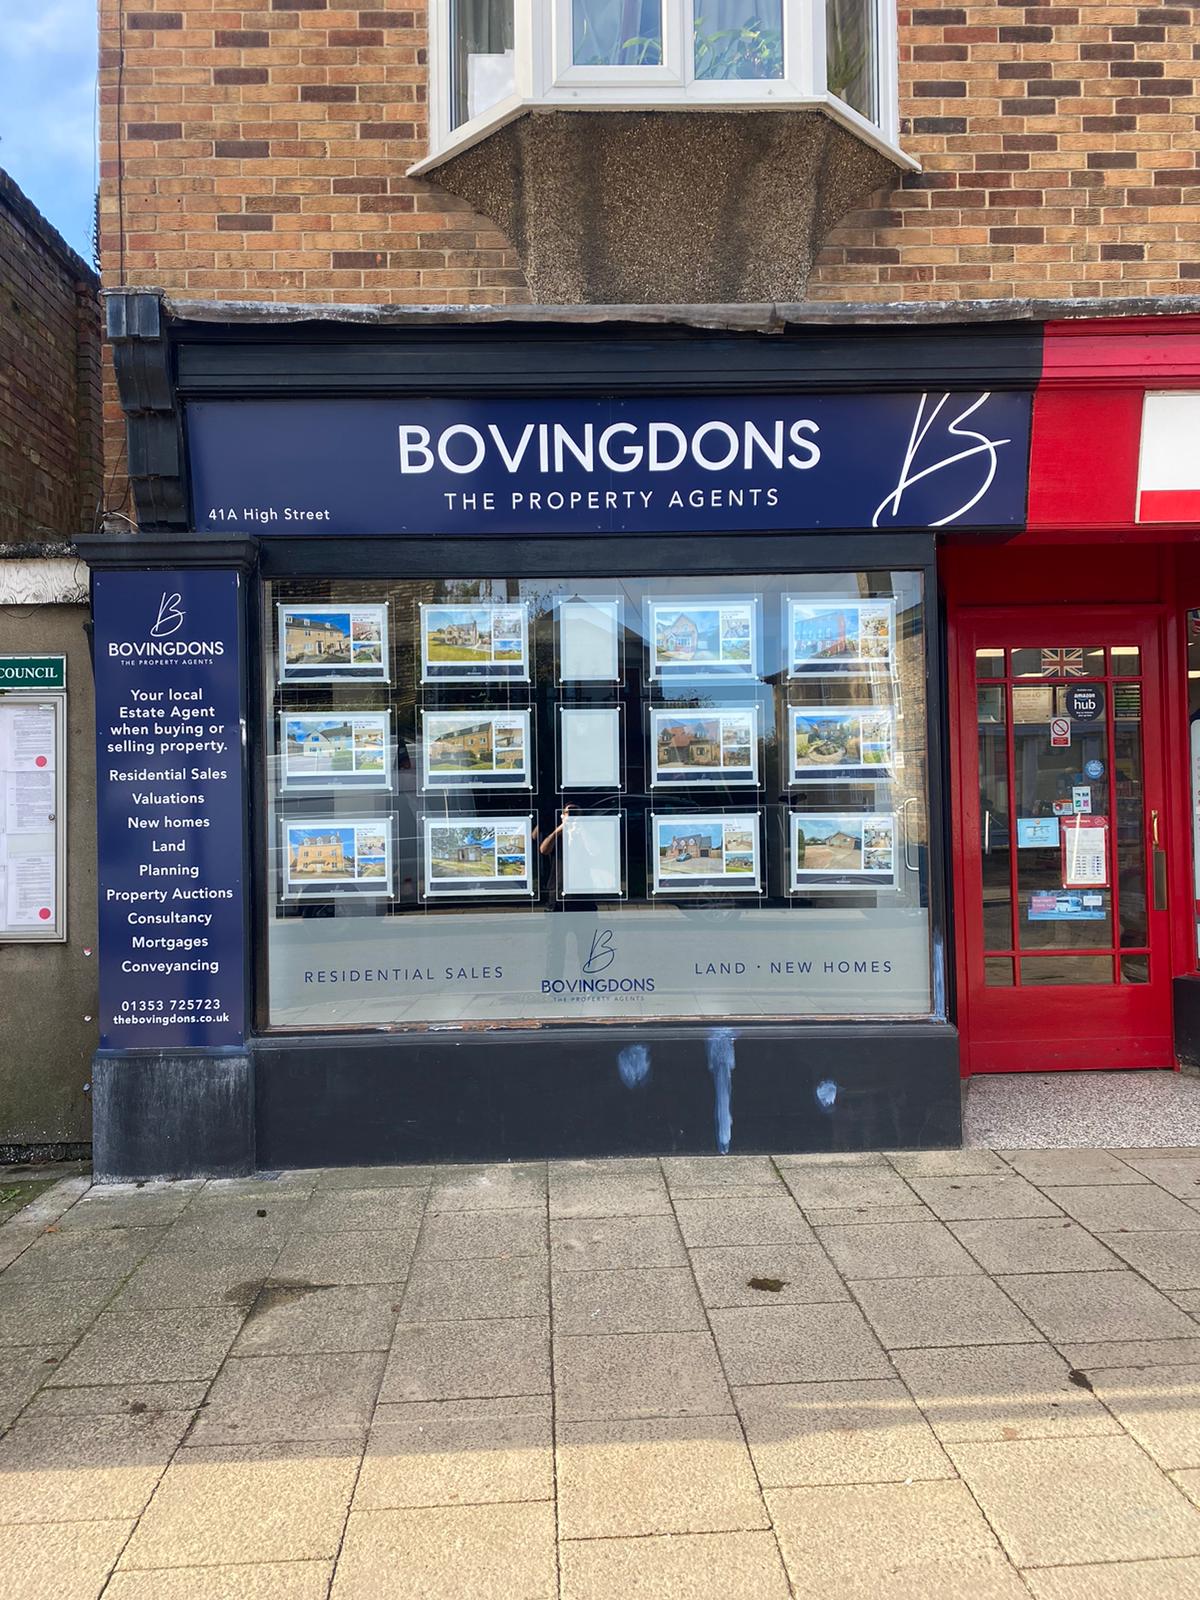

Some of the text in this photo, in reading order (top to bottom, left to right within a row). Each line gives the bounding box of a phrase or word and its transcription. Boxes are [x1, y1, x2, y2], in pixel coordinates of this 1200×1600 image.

[398, 419, 821, 474] BOVINGDONS
[444, 488, 780, 510] THE PROPERTY AGENTS
[208, 507, 331, 523] 41A High Street
[108, 641, 224, 657] BOVINGDONS
[130, 688, 203, 701] Your local
[1074, 699, 1096, 710] hub
[119, 705, 216, 720] Estate Agent
[110, 722, 225, 737] when buying or
[107, 739, 228, 755] selling property.
[109, 767, 227, 781] Residential Sales
[132, 792, 205, 805] Valuations
[127, 815, 210, 829] New homes
[152, 840, 186, 852] Land
[139, 864, 200, 878] Planning
[106, 887, 233, 903] Property Auctions
[127, 911, 213, 926] Consultancy
[132, 936, 209, 951] Mortgages
[121, 960, 219, 974] Conveyancing
[304, 966, 504, 983] RESIDENTIAL SALES
[695, 962, 746, 975] LAND
[770, 961, 813, 974] NEW
[823, 960, 893, 974] HOMES
[541, 978, 656, 993] BOVINGDONS
[121, 999, 221, 1012] 01353 725723
[113, 1012, 230, 1025] thebovingdons.co.uk
